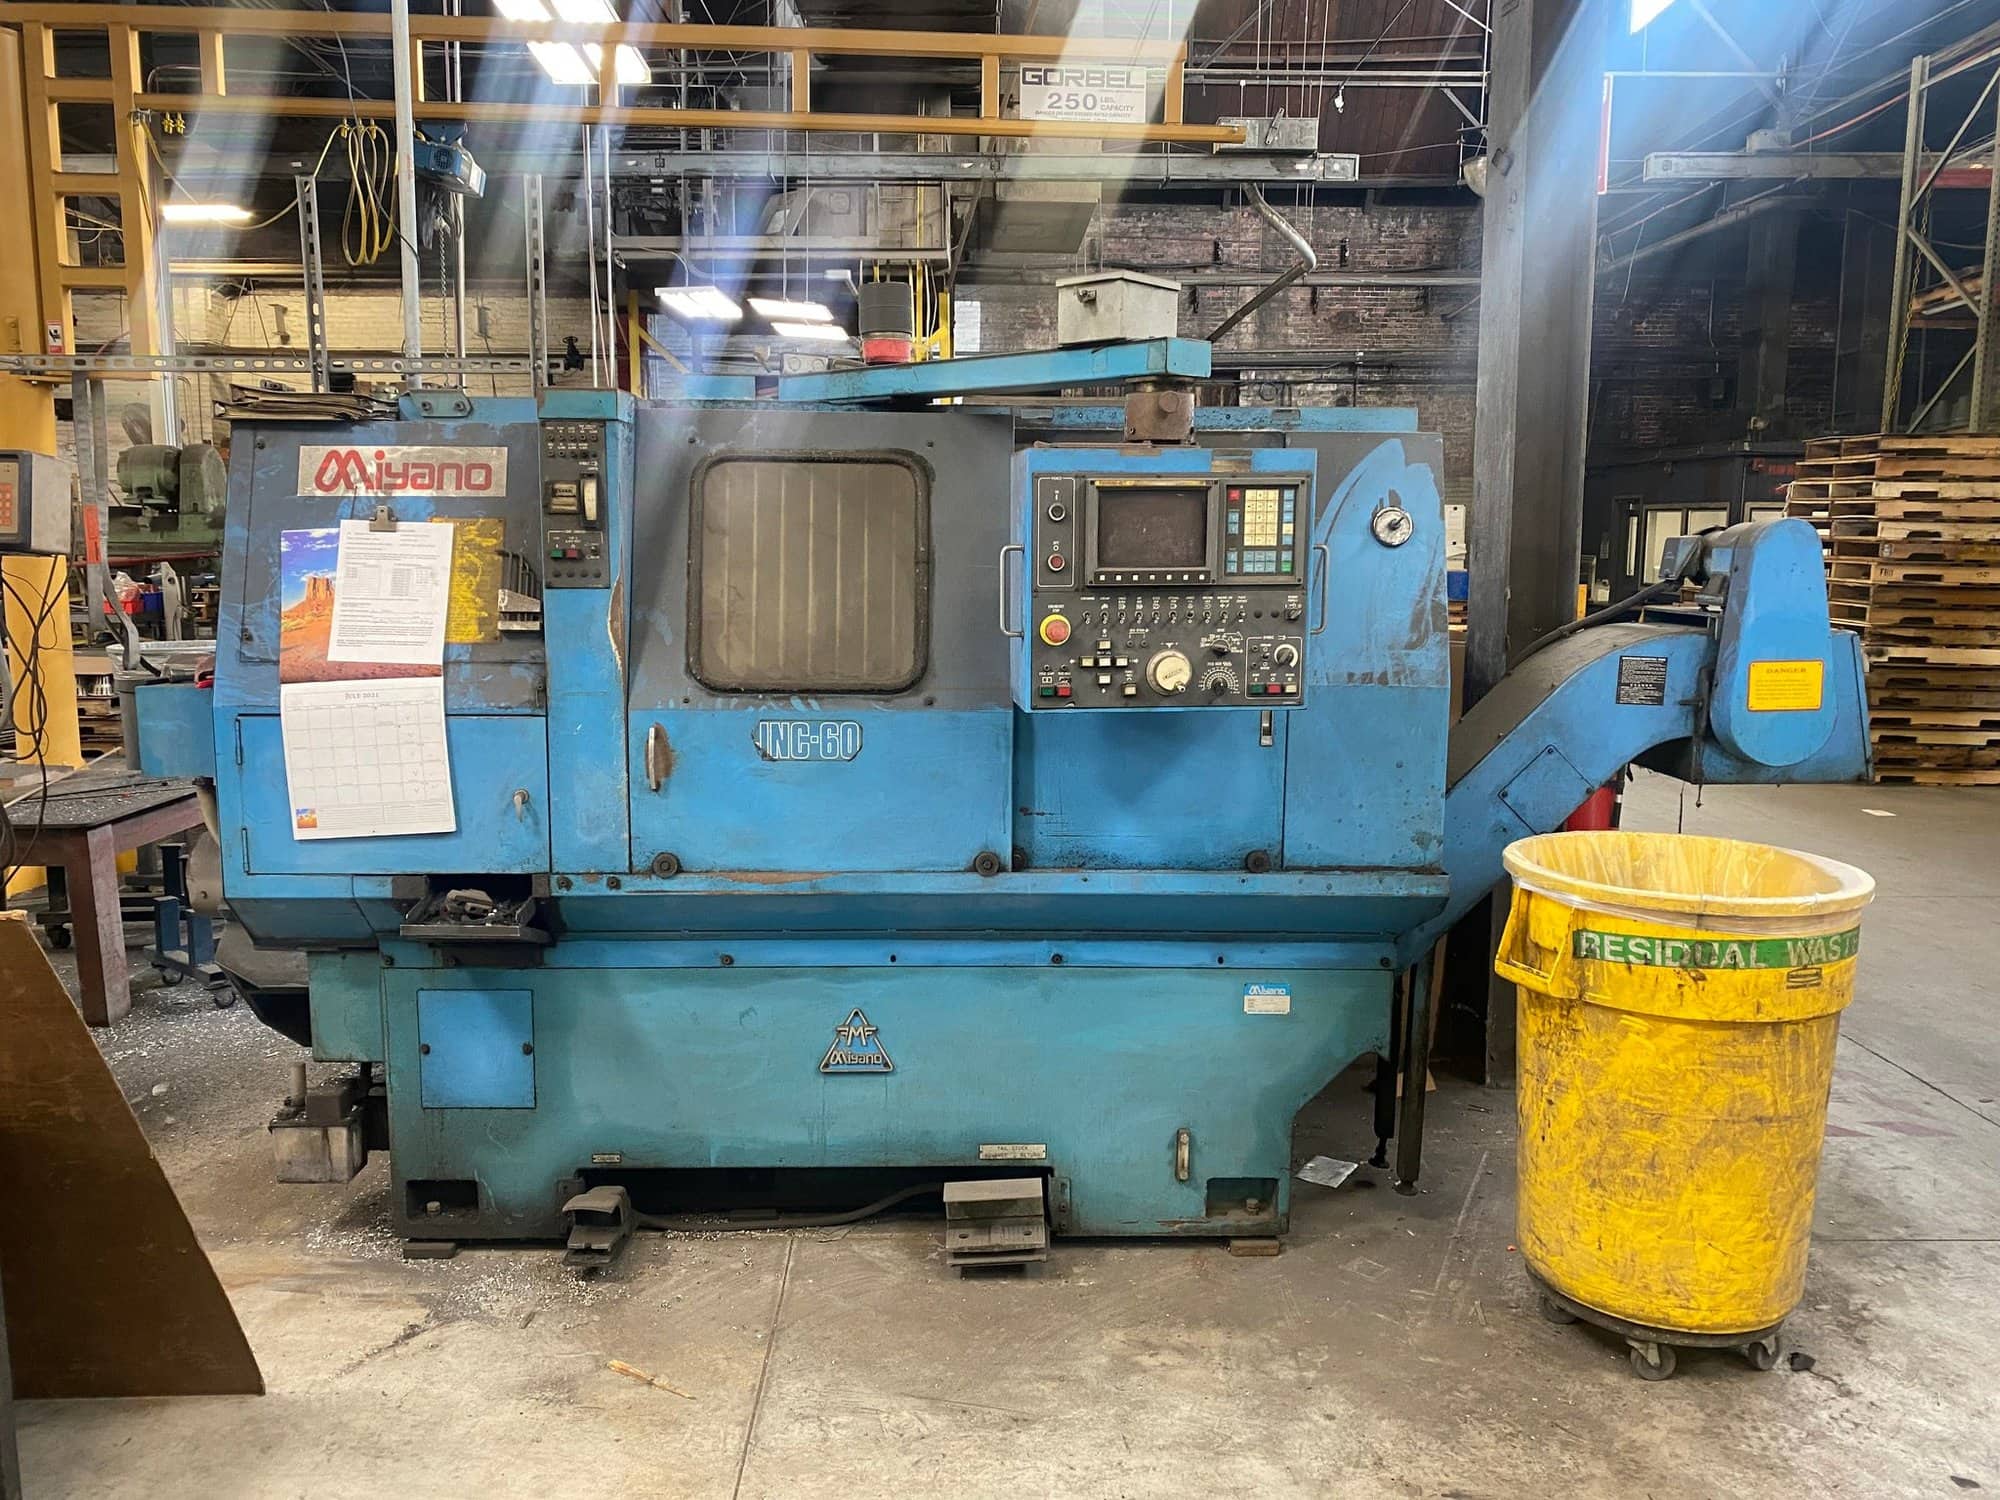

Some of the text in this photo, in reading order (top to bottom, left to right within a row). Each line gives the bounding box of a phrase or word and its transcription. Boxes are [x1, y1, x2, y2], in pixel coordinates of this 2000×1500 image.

[1022, 67, 1145, 88] GORBEL
[1047, 92, 1098, 111] 250
[1100, 104, 1135, 112] CAPACITY
[314, 449, 493, 493] Miyano
[1579, 931, 1768, 969] RESIDUAL
[829, 1050, 882, 1065] Miyano
